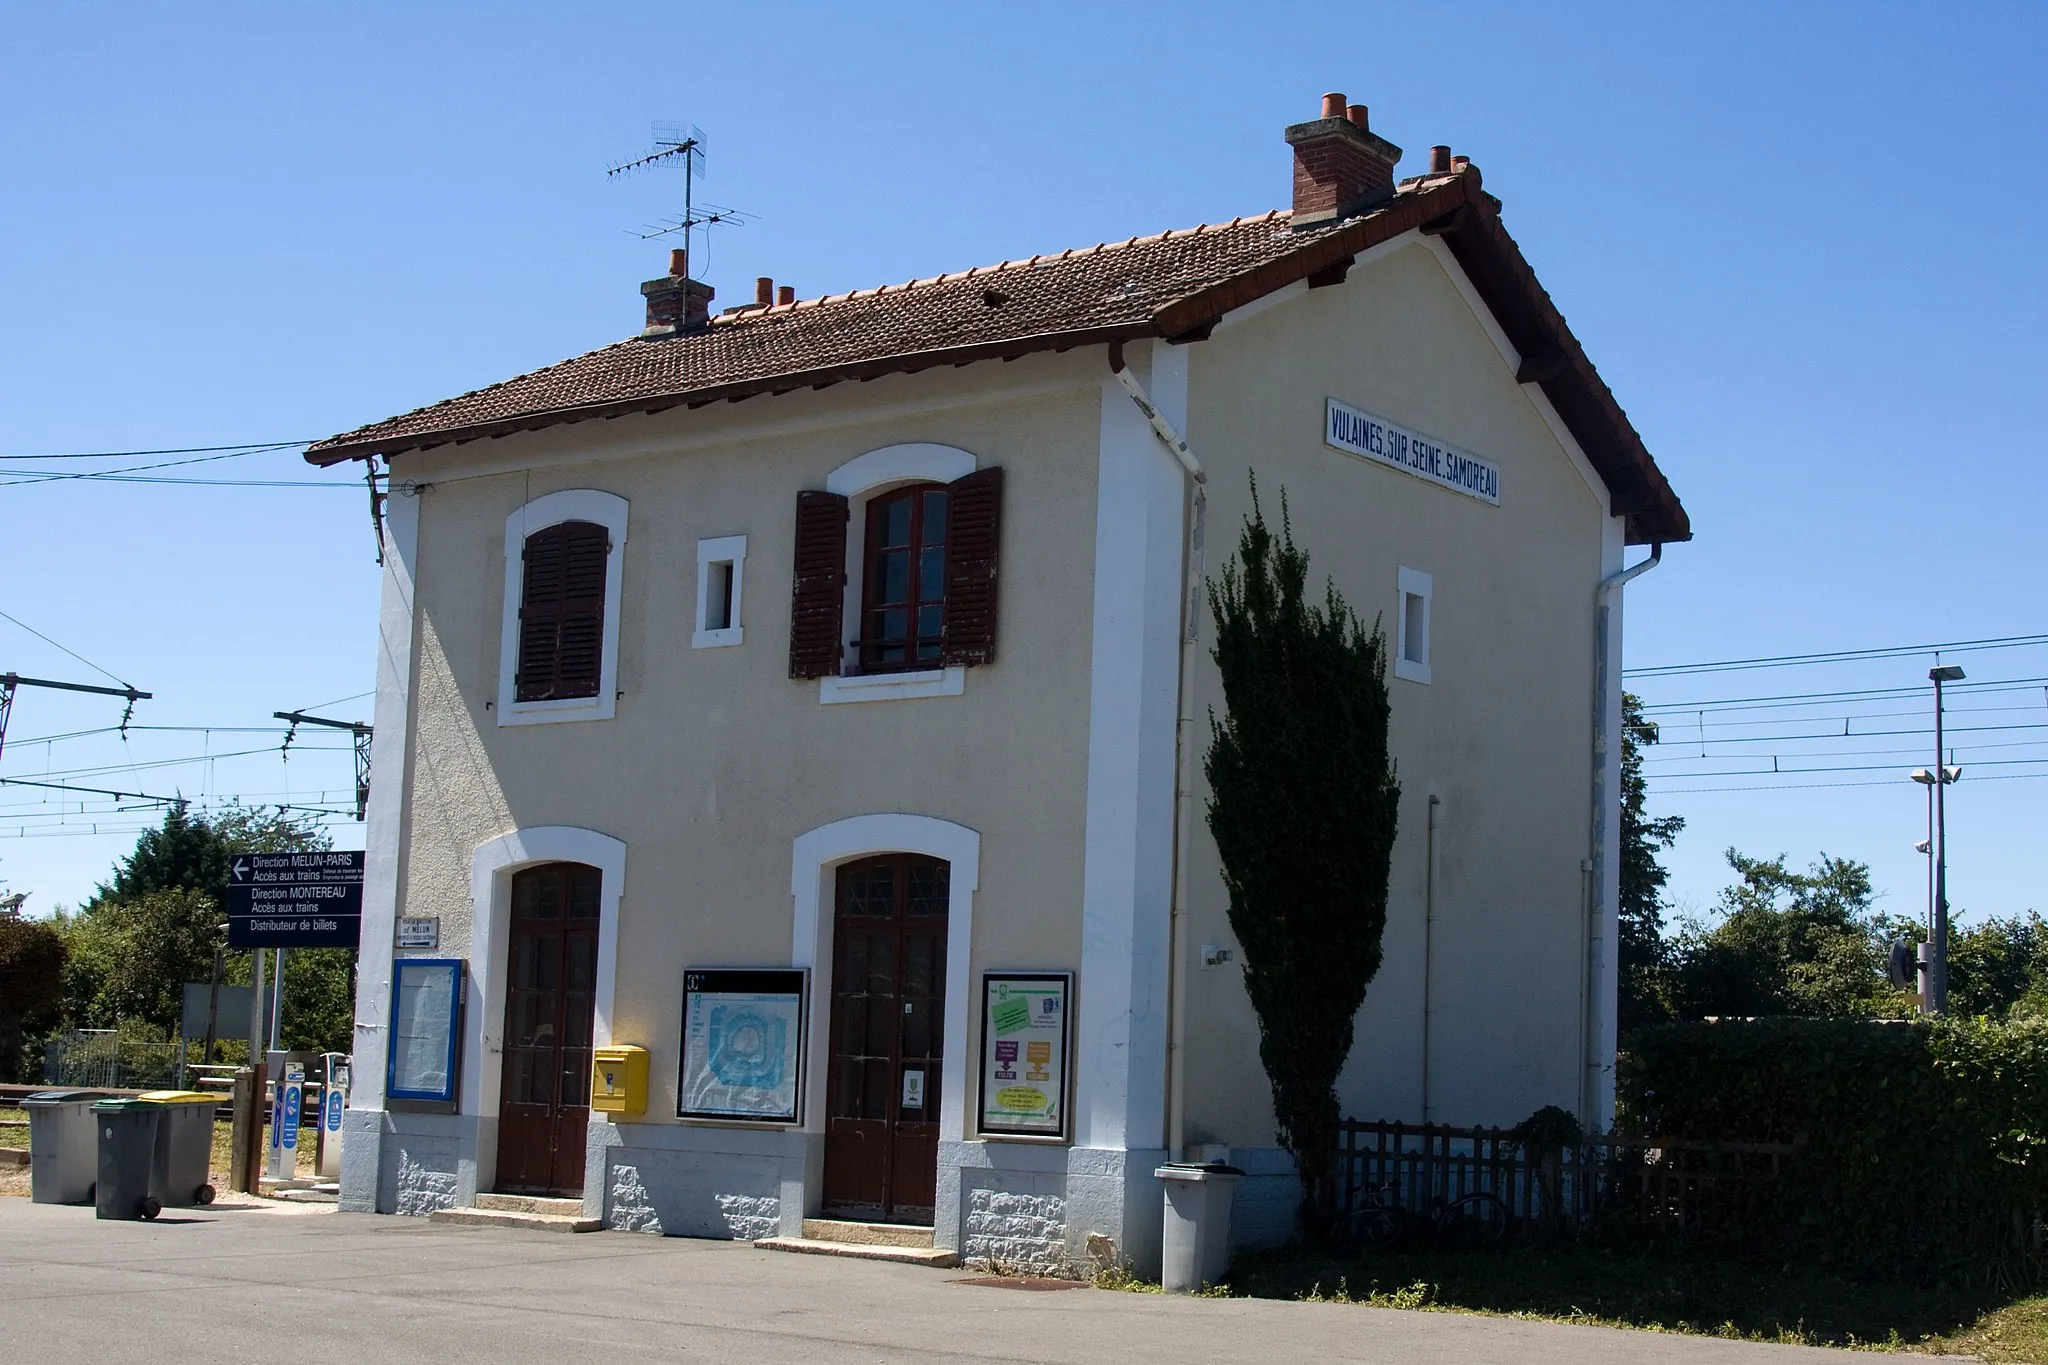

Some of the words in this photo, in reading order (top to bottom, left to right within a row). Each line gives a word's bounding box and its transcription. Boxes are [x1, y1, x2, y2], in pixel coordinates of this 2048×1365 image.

[252, 856, 289, 868] Direction
[291, 853, 353, 867] MELUN-PARIS
[252, 870, 277, 881] Accès
[280, 872, 295, 881] aux
[297, 868, 321, 880] trains
[251, 887, 288, 899] Direction
[290, 886, 346, 899] MONTEREAU
[251, 902, 276, 912] Accès
[278, 903, 293, 912] aux
[296, 901, 319, 912] trains
[250, 920, 297, 931] Distributeur
[300, 919, 311, 930] de
[313, 919, 337, 931] billets
